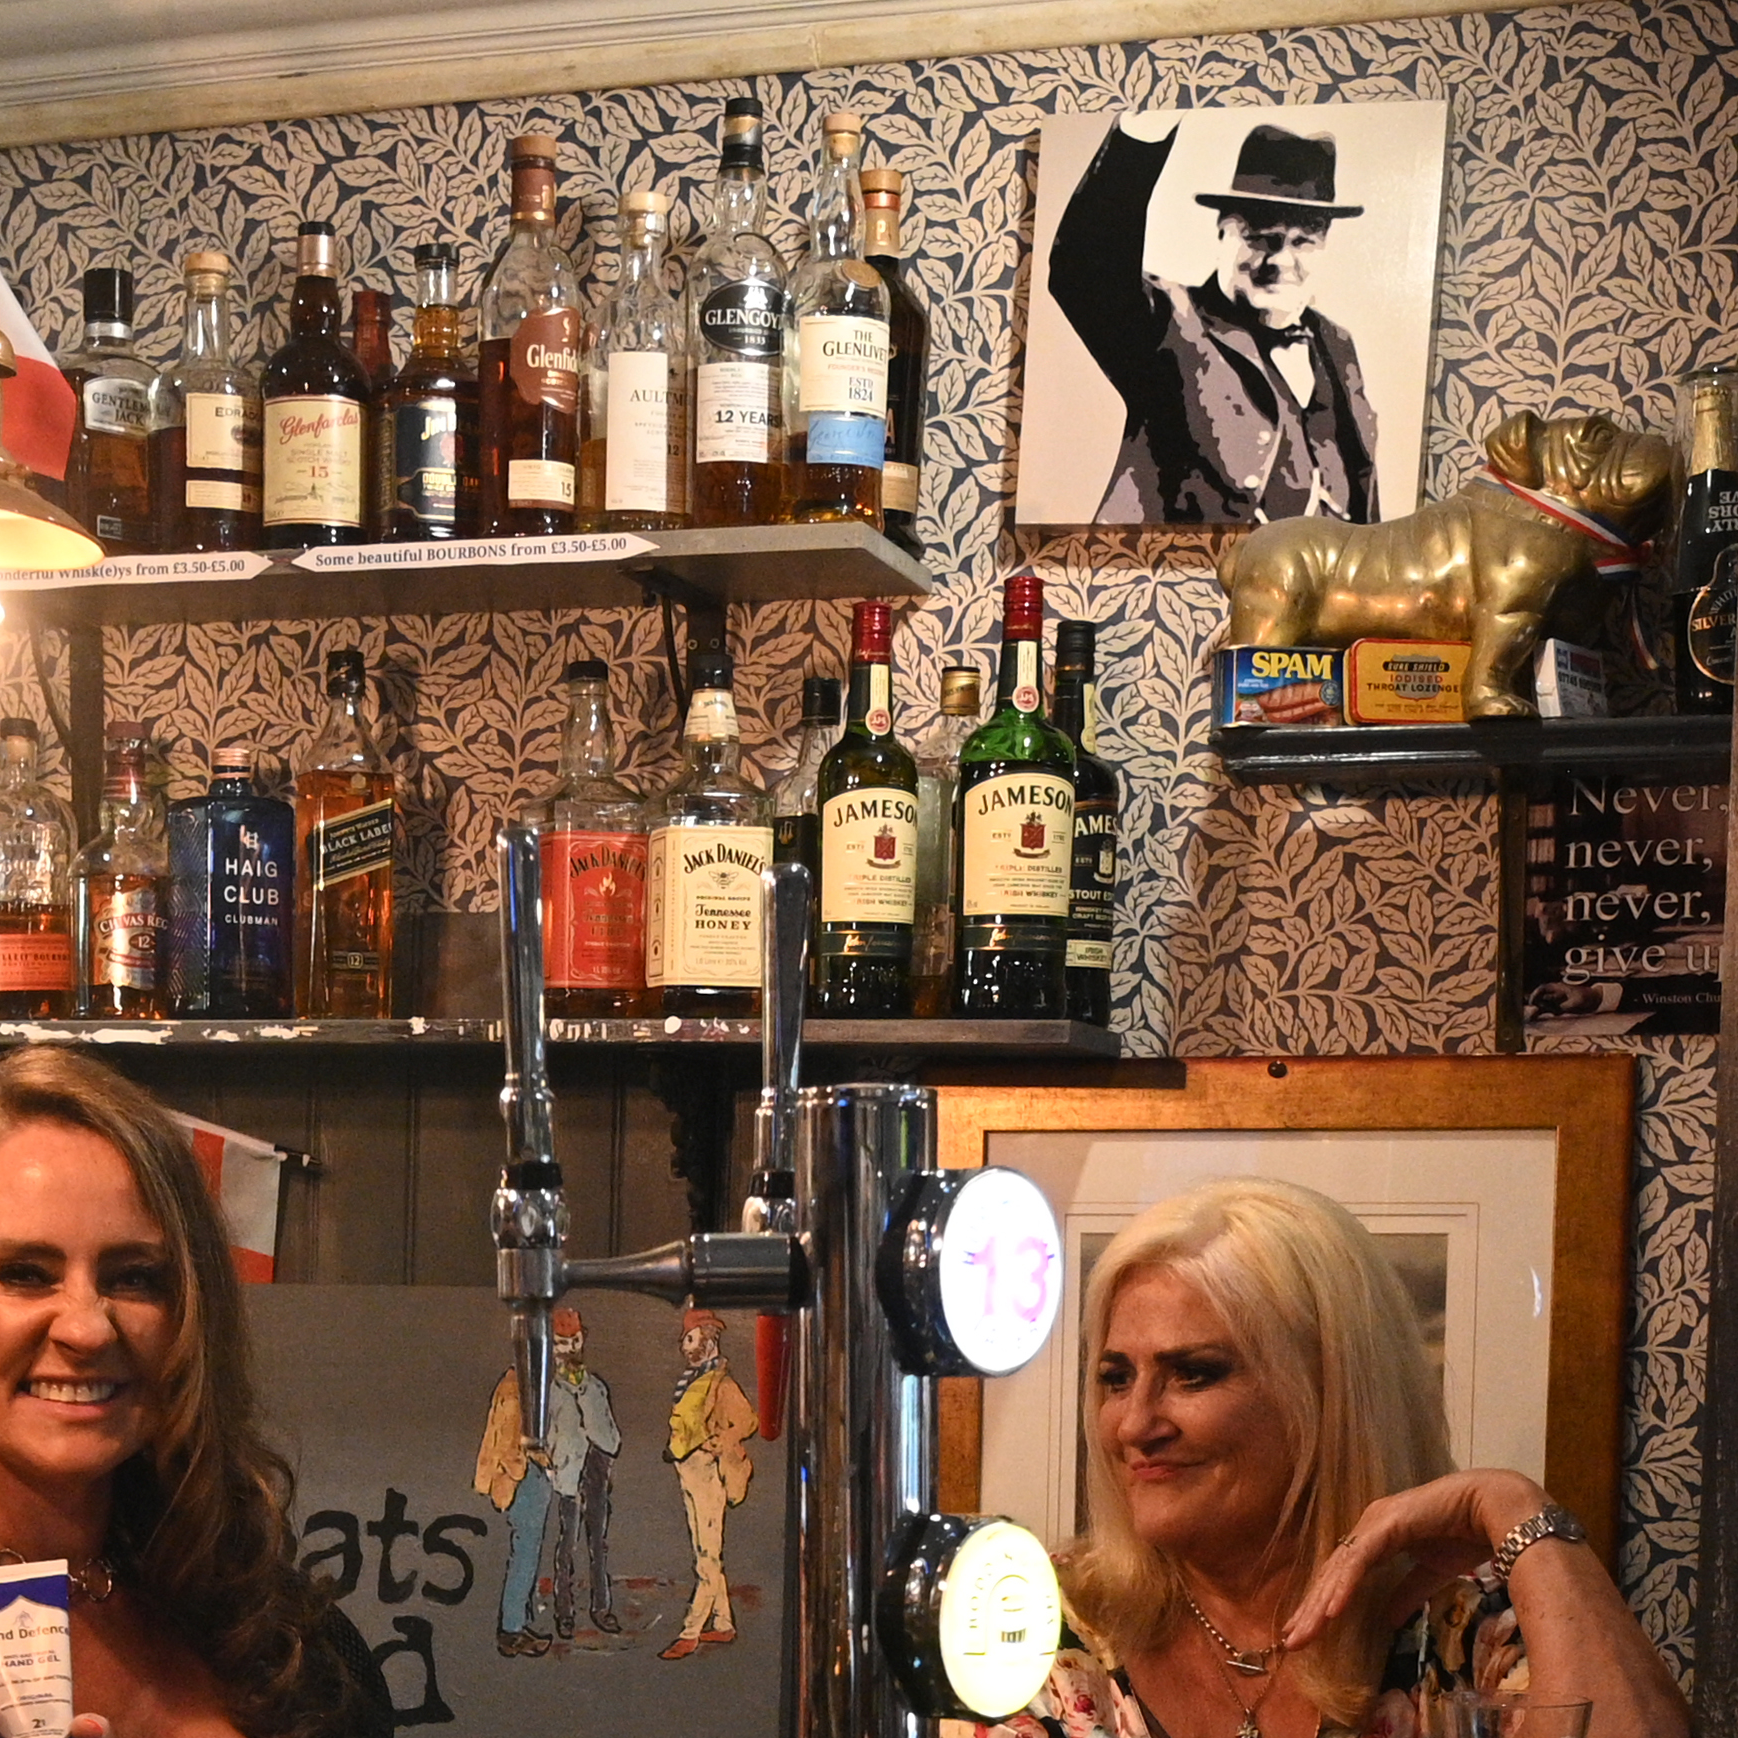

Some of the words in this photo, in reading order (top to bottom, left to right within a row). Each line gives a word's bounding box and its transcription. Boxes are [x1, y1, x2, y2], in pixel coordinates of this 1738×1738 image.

[853, 329, 873, 343] THE
[629, 389, 684, 406] AULTM
[848, 387, 873, 402] 1824
[115, 409, 144, 427] JACK
[716, 409, 734, 424] 12
[279, 408, 359, 445] Glenfarclas
[310, 466, 330, 479] 15
[561, 481, 572, 497] 15
[315, 551, 354, 568] Some
[358, 548, 423, 565] beautiful
[426, 543, 507, 561] BOURBONS
[511, 541, 547, 557] from
[551, 537, 628, 554] £3.50-£5.00
[136, 561, 168, 577] from
[172, 559, 246, 576] £3.50-£5.00
[1252, 652, 1334, 680] SPAM
[1412, 662, 1446, 672] SHIELD
[1390, 674, 1444, 684] IODISED
[1367, 683, 1408, 692] THROAT
[978, 785, 1075, 818] JAMESON
[1568, 777, 1730, 817] Never,
[1075, 814, 1118, 839] AMES
[683, 848, 715, 875] JACK
[717, 842, 766, 876] DANIEL'S
[1565, 837, 1713, 874] never,
[225, 857, 278, 878] HAIG
[570, 850, 599, 879] JACK
[224, 884, 280, 906] CLUB
[1069, 889, 1102, 901] STOUT
[695, 903, 752, 918] Tennessee
[1564, 889, 1711, 926] never,
[225, 914, 279, 926] CLUBMAN
[695, 918, 753, 931] HONEY
[138, 937, 151, 948] 12
[350, 954, 361, 967] 12
[1562, 933, 1666, 985] give
[1642, 992, 1692, 1004] Winston
[295, 1487, 488, 1605] ats
[18, 1624, 70, 1640] Defence
[38, 1654, 61, 1665] GEL
